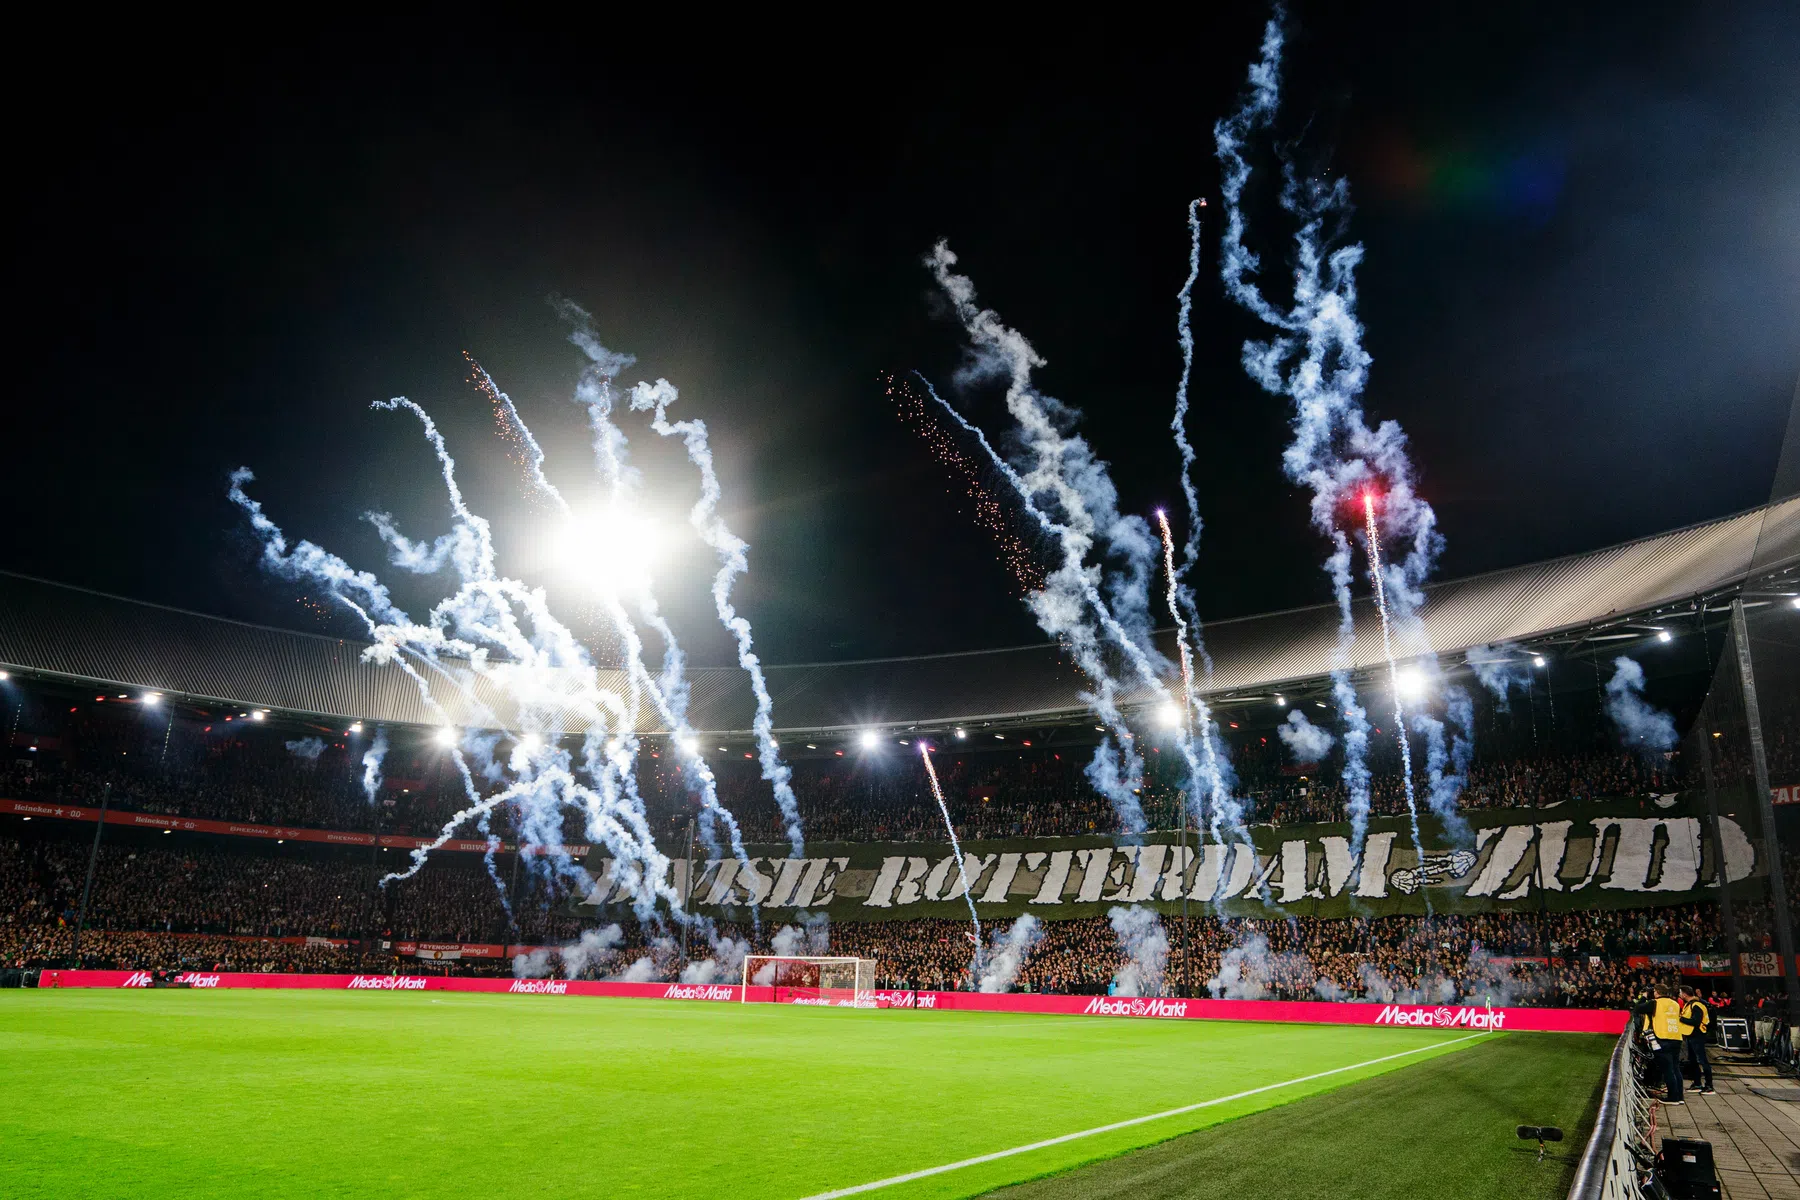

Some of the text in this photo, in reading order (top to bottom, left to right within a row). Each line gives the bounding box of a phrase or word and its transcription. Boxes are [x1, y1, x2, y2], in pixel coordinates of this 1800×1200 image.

[14, 803, 53, 814] Heineken
[135, 815, 169, 826] Heineken
[862, 831, 1397, 908] ROTTERDAM
[1749, 952, 1772, 963] RED
[348, 975, 427, 990] Media Markt
[509, 979, 568, 995] Media Markt
[664, 984, 733, 1001] Media Markt
[1084, 997, 1188, 1017] Media Markt
[1375, 1004, 1506, 1028] Media Markt
